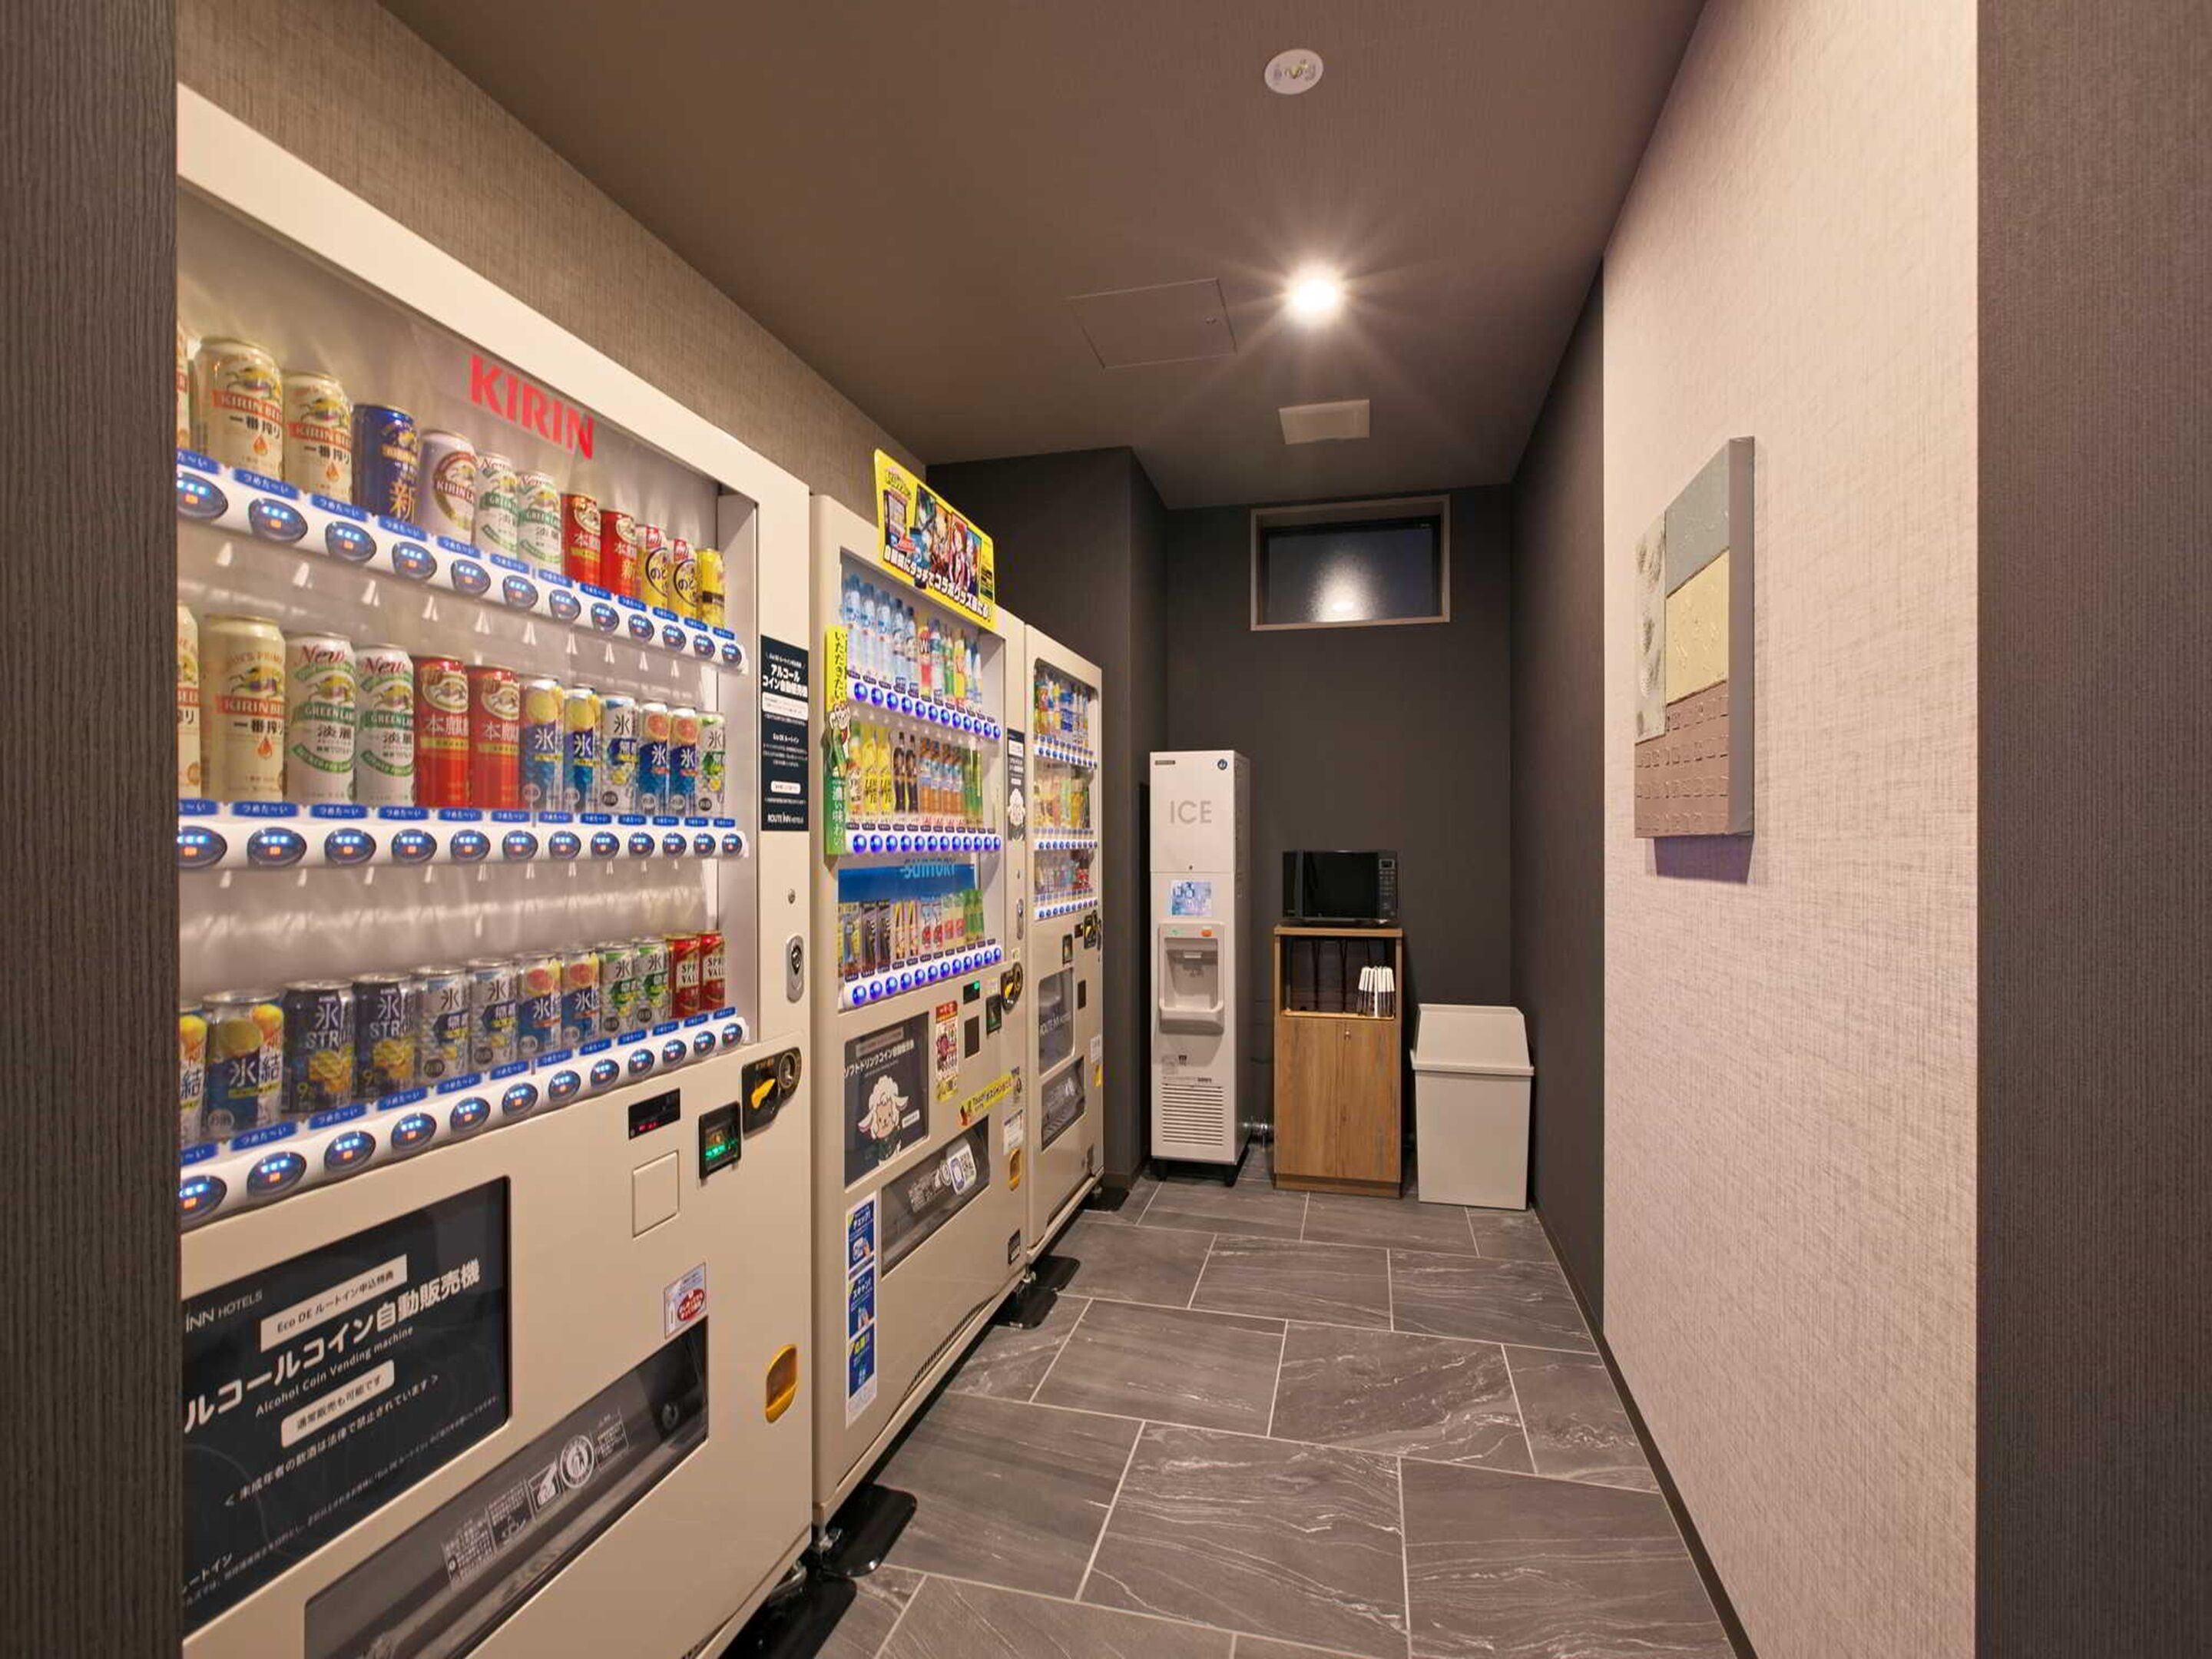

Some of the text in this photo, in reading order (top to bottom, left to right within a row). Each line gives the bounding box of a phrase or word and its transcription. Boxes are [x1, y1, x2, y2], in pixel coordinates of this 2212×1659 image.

[471, 353, 595, 460] KIRIN
[300, 644, 346, 663] New
[364, 656, 405, 674] New
[225, 698, 267, 713] KIRIN
[1170, 800, 1213, 825] ICE
[441, 987, 460, 1010] 氷
[487, 979, 506, 1002] 氷
[314, 1002, 339, 1031] 氷
[377, 995, 400, 1019] 氷
[185, 1289, 263, 1333] INN HOTELS
[276, 1316, 296, 1334] Eco
[298, 1310, 313, 1325] DE
[255, 1325, 414, 1419] Alcohol Coin Vending machine
